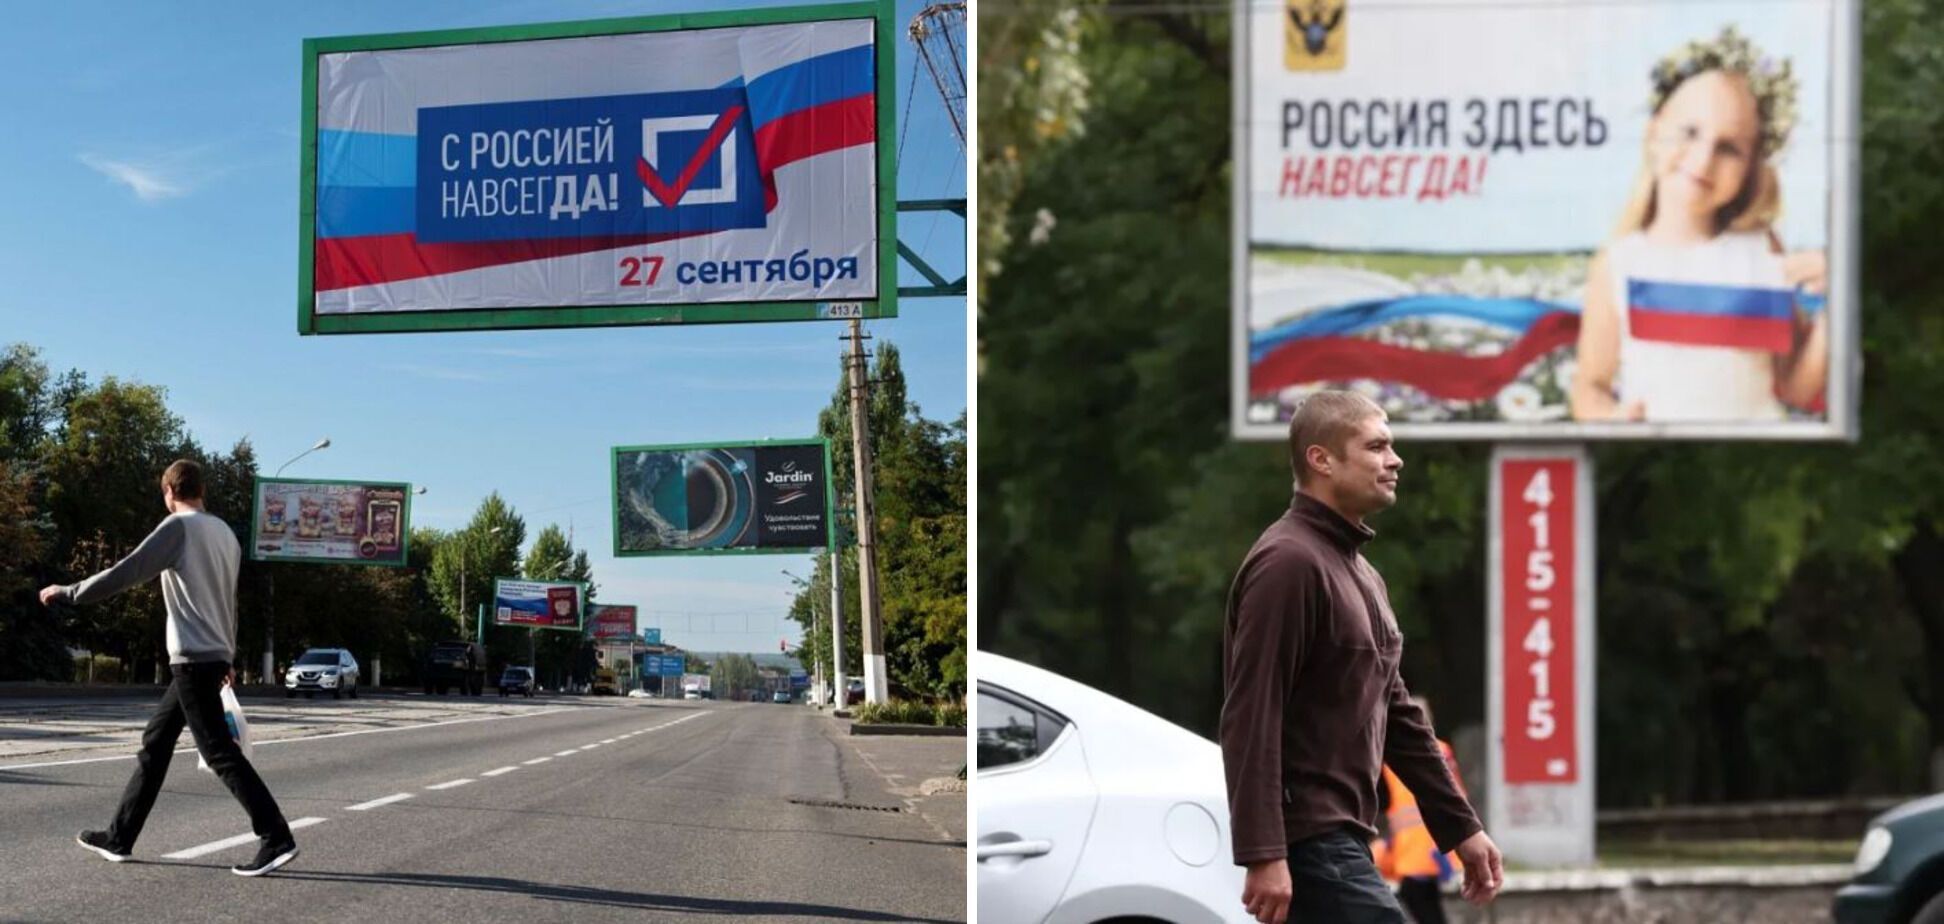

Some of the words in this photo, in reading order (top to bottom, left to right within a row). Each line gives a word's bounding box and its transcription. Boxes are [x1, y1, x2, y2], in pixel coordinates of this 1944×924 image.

[441, 133, 460, 171] С
[470, 117, 615, 168] РОССИЕЙ
[1281, 99, 1450, 149] РОССИЯ
[1464, 97, 1609, 154] ЗДЕСЬ
[441, 174, 619, 221] НАВСЕГДА!
[1278, 154, 1489, 203] НАВСЕГДА!
[619, 256, 664, 286] 27
[676, 249, 859, 287] сентября
[830, 305, 849, 316] 413
[765, 471, 812, 483] Jardin
[764, 514, 820, 522] Удовольствие
[769, 524, 817, 532] чувствовать
[1522, 468, 1556, 741] 415-415
